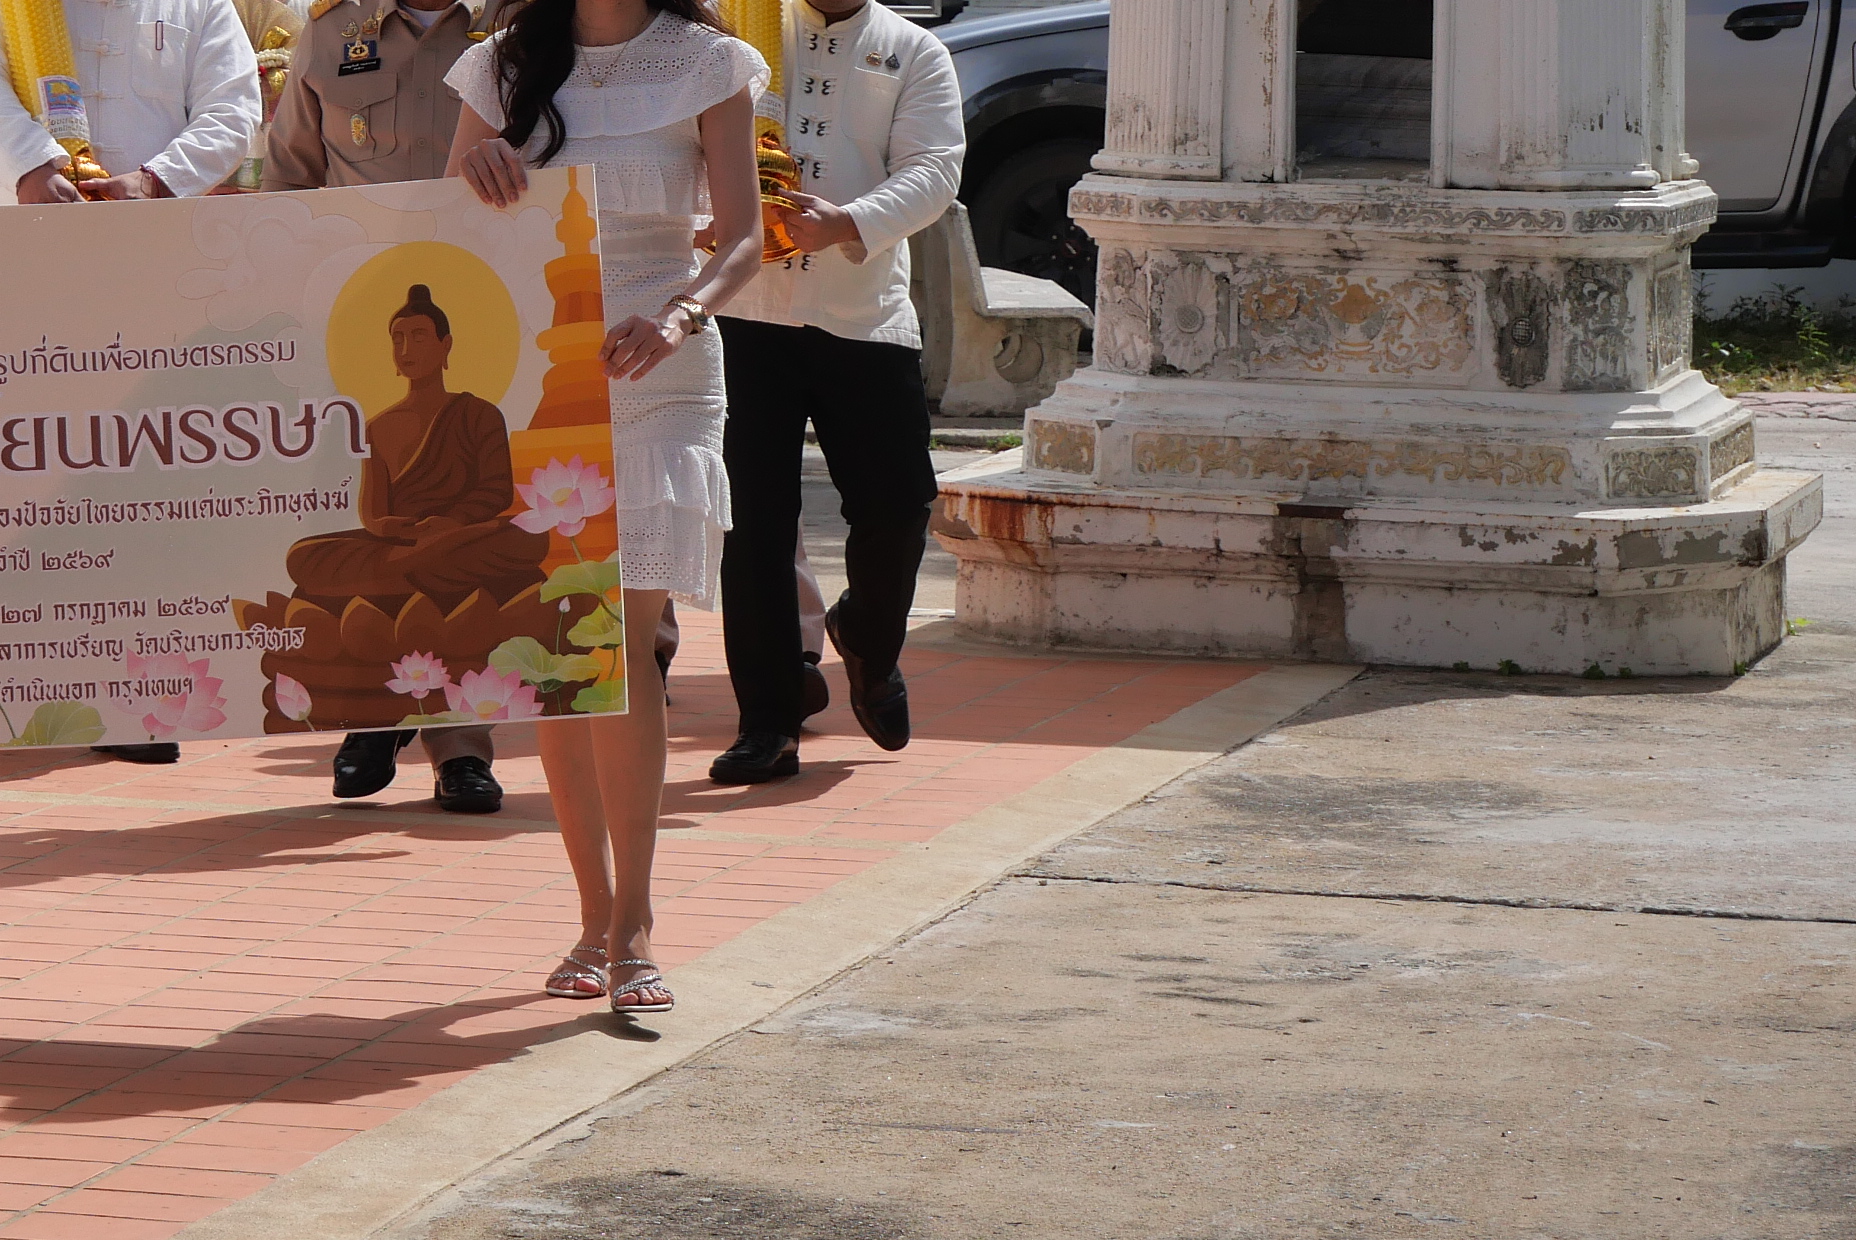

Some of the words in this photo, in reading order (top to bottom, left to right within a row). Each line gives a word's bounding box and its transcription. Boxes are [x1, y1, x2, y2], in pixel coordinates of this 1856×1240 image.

[42, 549, 114, 571] ๒๕๖๙
[1, 603, 42, 624] ๒๗
[158, 595, 230, 617] ๒๕๖๙
[108, 677, 193, 705] กรุงเทพฯ
